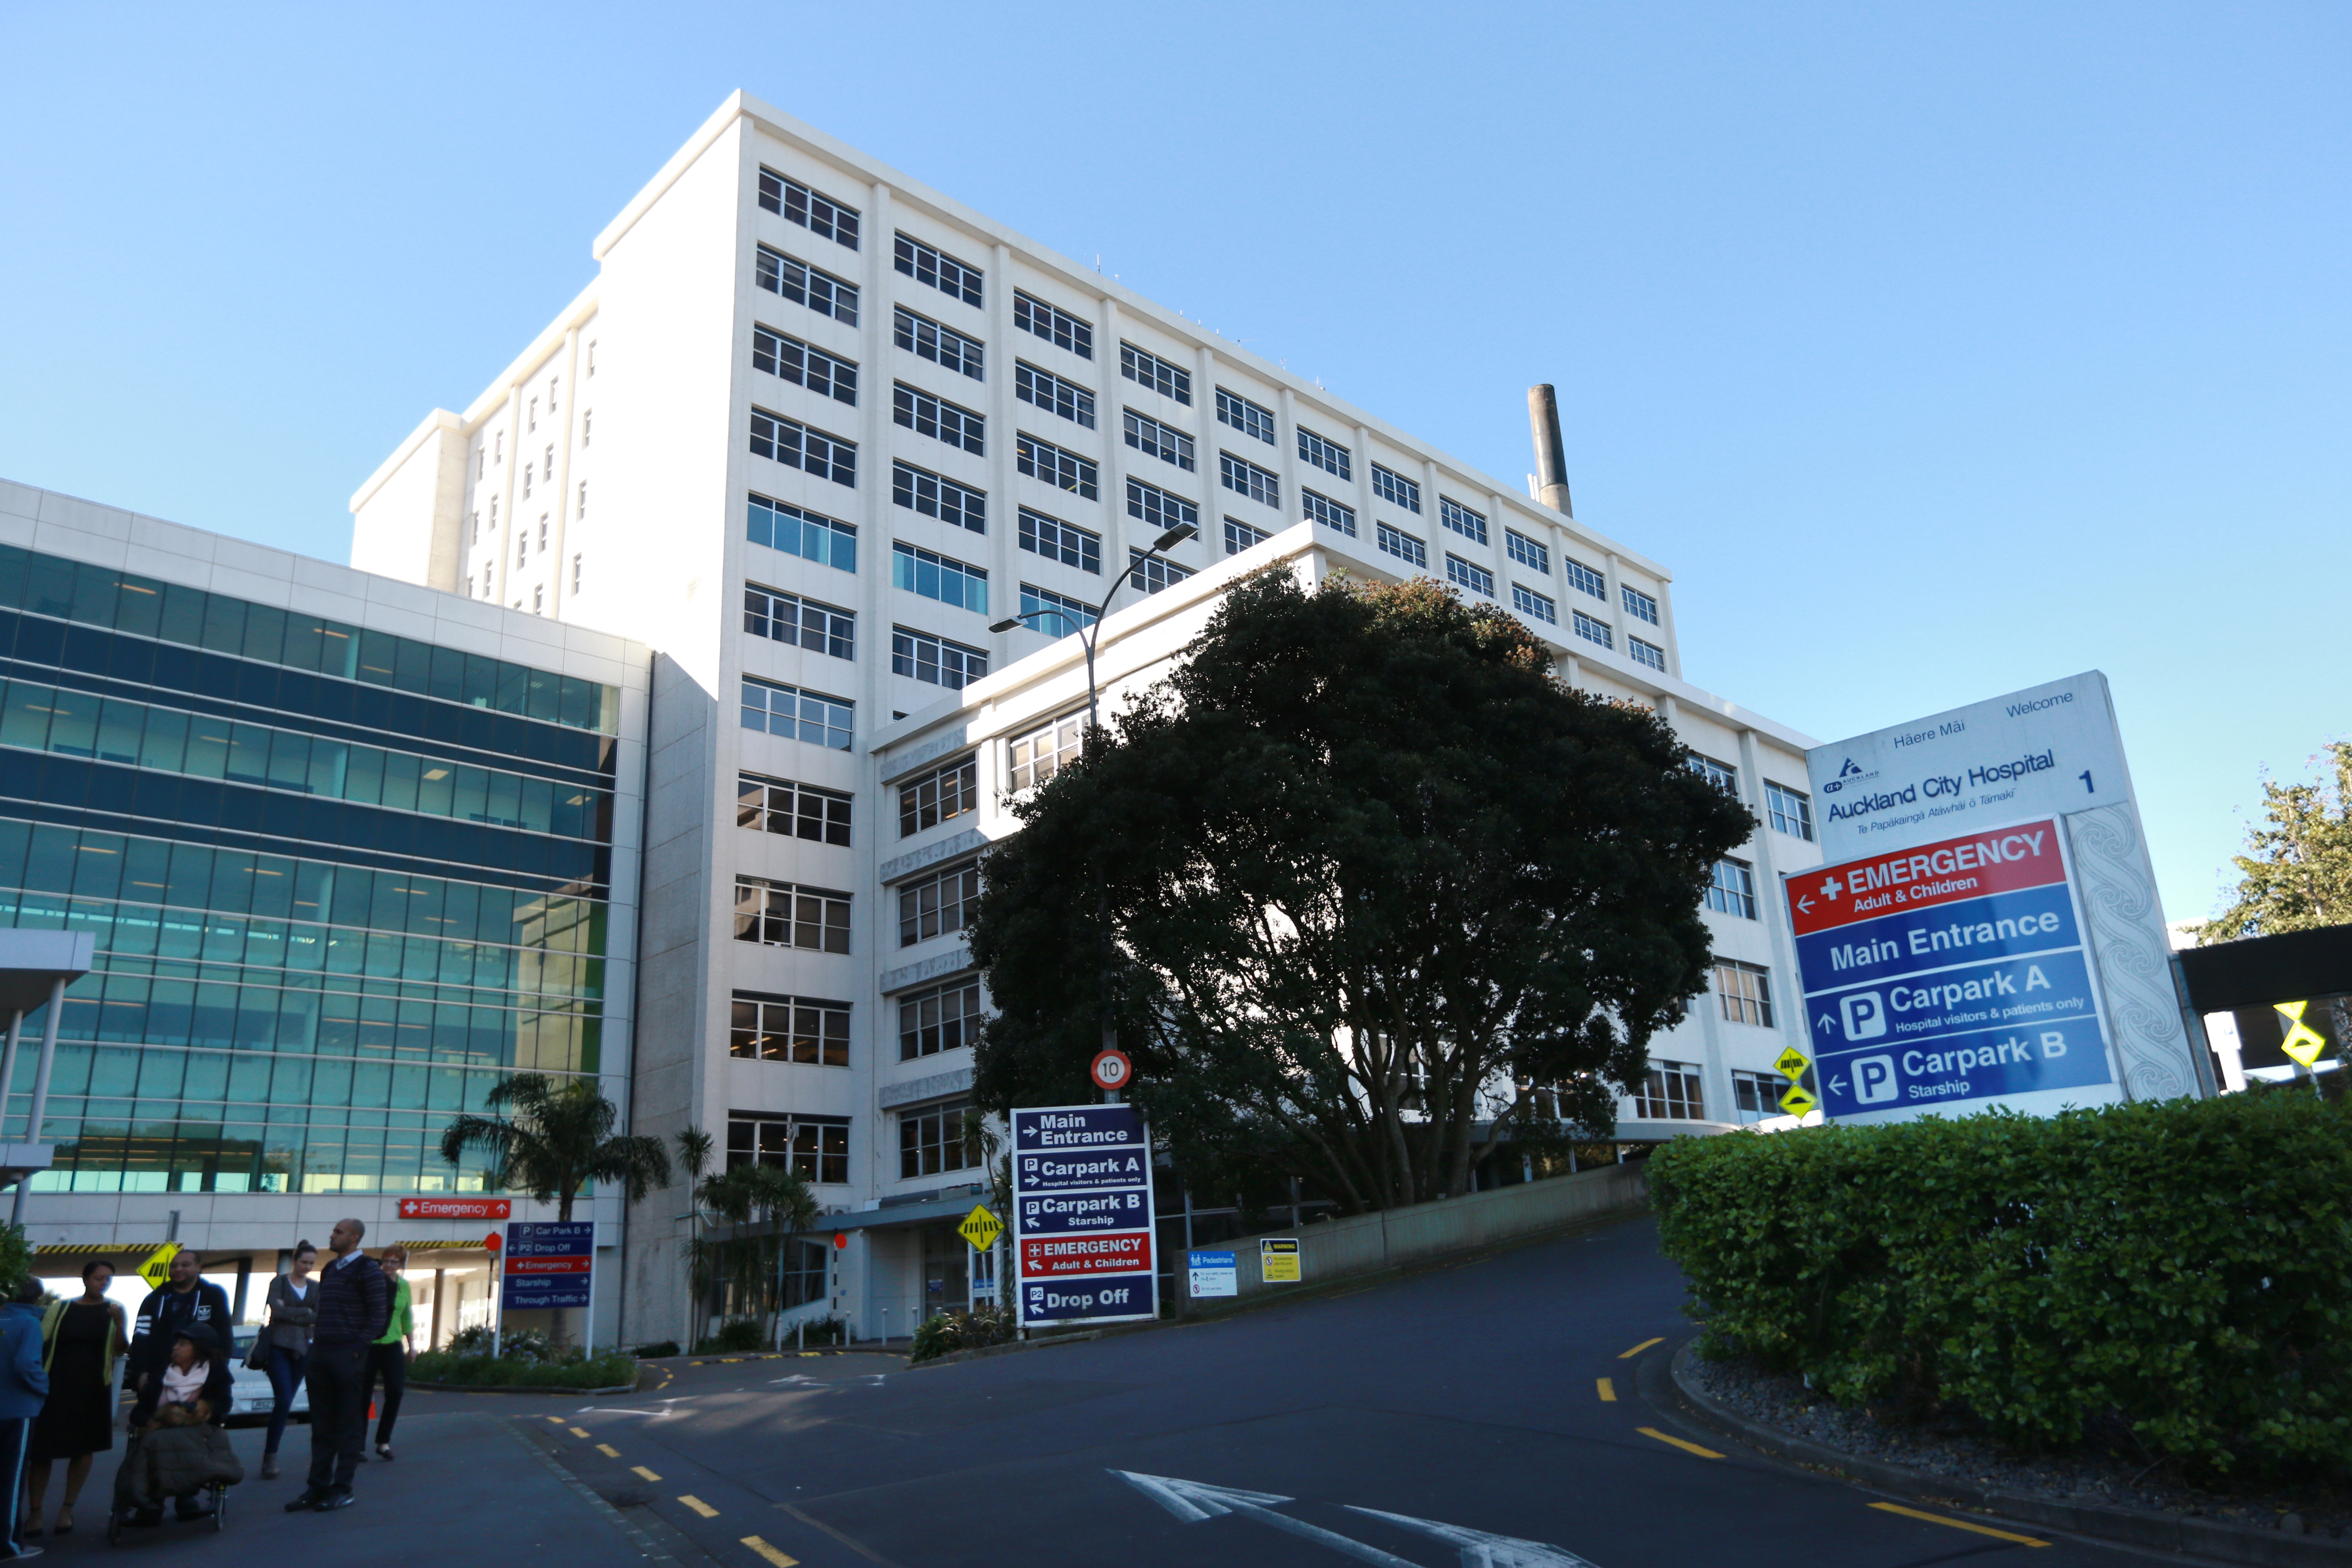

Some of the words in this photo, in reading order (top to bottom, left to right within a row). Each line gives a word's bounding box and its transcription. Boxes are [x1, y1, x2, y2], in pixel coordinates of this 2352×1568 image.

[2006, 691, 2073, 717] Welcome
[1894, 727, 1935, 750] Hāere
[1940, 720, 1965, 738] Māi
[1828, 784, 1916, 822] Auckland
[1922, 773, 1963, 799] City
[1968, 749, 2054, 788] Hospital
[1843, 771, 1879, 784] AUCKLAND
[2079, 770, 2094, 794] 1
[1857, 824, 1867, 834] Te
[1870, 811, 1925, 832] Papākaingā
[1847, 830, 2045, 895] EMERGENCY
[1854, 892, 1891, 912] Adult
[1895, 888, 1906, 902] &
[1911, 876, 1977, 898] Children
[1830, 939, 1898, 971] Main
[1908, 912, 2060, 955] Entrance
[1849, 999, 1876, 1034] P
[1890, 971, 2017, 1009] Carpark
[2025, 965, 2051, 992] A
[1896, 1015, 1941, 1033] Hospital
[1944, 1010, 1985, 1025] visitors
[1990, 1008, 1999, 1018] &
[2002, 1002, 2053, 1020] patients
[2056, 997, 2084, 1012] only
[1103, 1062, 1119, 1077] 10
[1861, 1063, 1886, 1097] P
[1903, 1037, 2030, 1078] Carpark
[2040, 1032, 2067, 1058] B
[1908, 1080, 1970, 1100] Starship
[1040, 1114, 1086, 1129] Main
[1041, 1129, 1128, 1145] Entrance
[1028, 1160, 1035, 1170] P
[1042, 1159, 1119, 1177] Carpark
[1126, 1157, 1139, 1171] A
[421, 1202, 488, 1215] Emergency
[1029, 1204, 1037, 1212] P
[1043, 1196, 1121, 1214] Carpark
[1127, 1195, 1140, 1208] B
[1068, 1216, 1114, 1226] Starship
[534, 1244, 556, 1254] Drop
[1044, 1239, 1141, 1255] EMERGENCY
[525, 1261, 573, 1270] Emergency
[1052, 1261, 1080, 1270] Adult
[1084, 1260, 1092, 1269] &
[1095, 1258, 1139, 1267] Children
[516, 1278, 551, 1288] Starship
[515, 1295, 549, 1306] Through
[552, 1294, 578, 1303] Traffic
[1031, 1289, 1042, 1298] P2
[1047, 1293, 1093, 1309] Drop
[1099, 1289, 1129, 1304] Off
